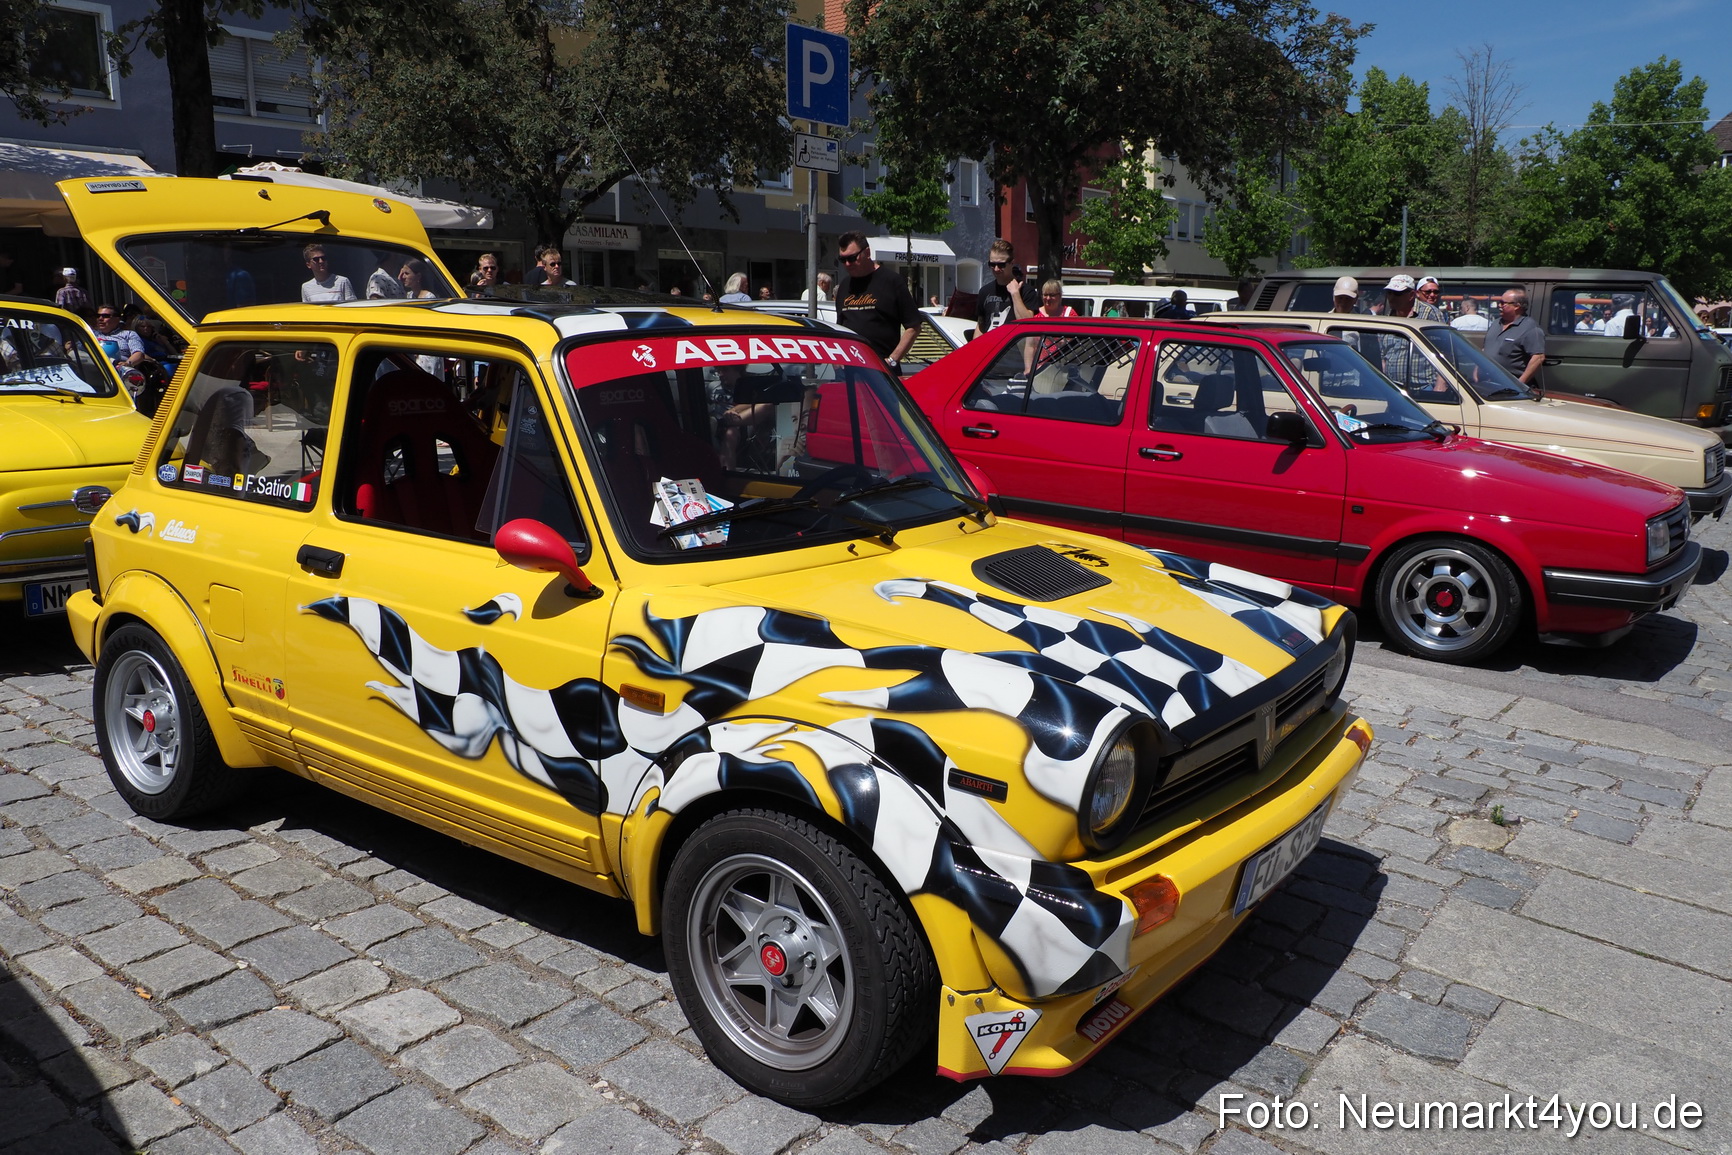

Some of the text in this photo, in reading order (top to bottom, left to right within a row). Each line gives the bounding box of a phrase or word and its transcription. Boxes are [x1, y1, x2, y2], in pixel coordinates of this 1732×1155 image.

[803, 39, 835, 108] P
[568, 225, 629, 239] CASAMILANA
[843, 293, 877, 307] Cadillac
[675, 337, 851, 364] ABARTH
[35, 373, 64, 385] 613
[245, 474, 292, 499] F.Satiro
[960, 777, 994, 792] ABARTH
[979, 1022, 1024, 1035] KONI
[1081, 1000, 1131, 1042] MOTUL
